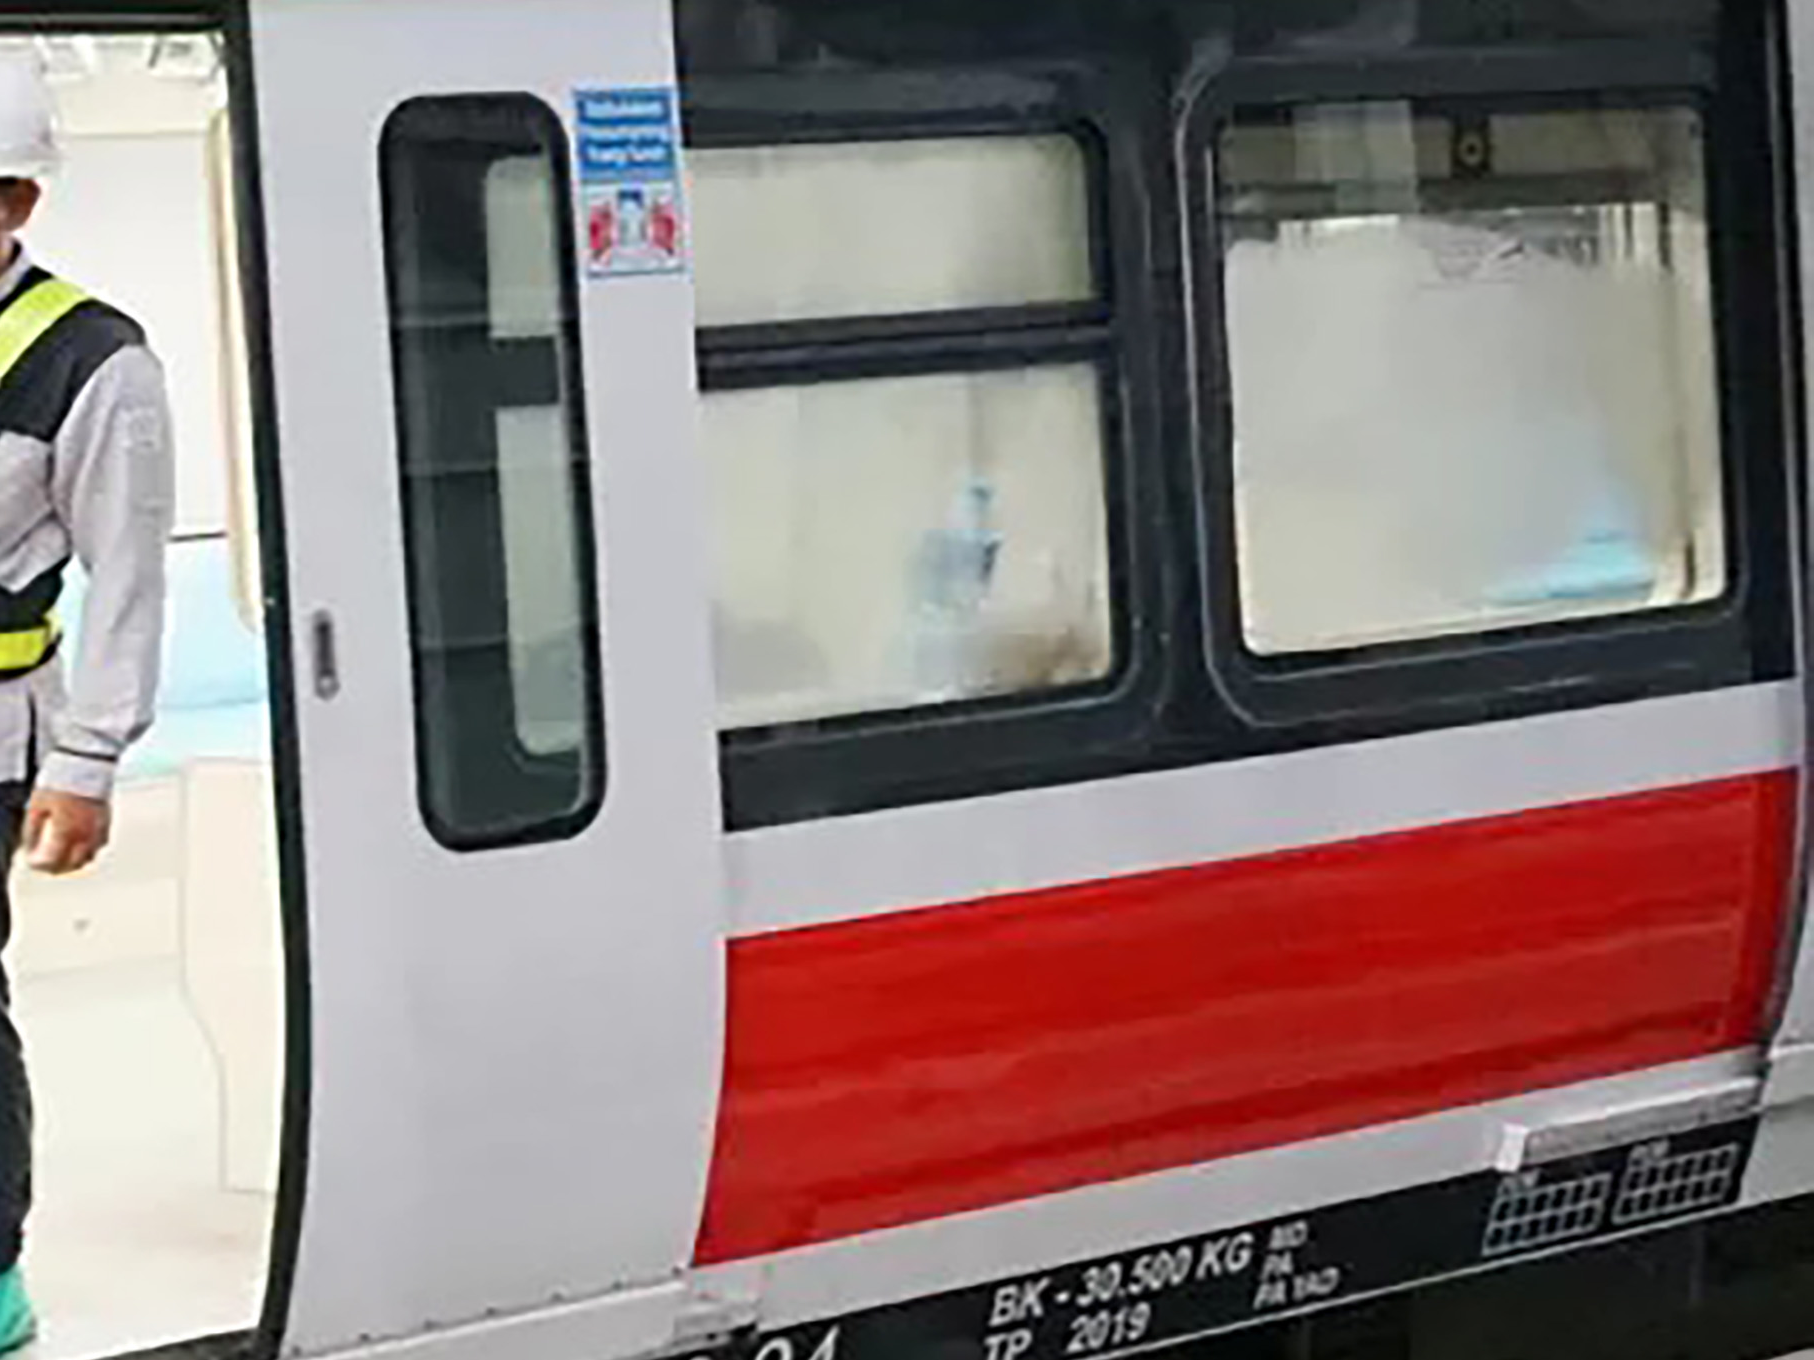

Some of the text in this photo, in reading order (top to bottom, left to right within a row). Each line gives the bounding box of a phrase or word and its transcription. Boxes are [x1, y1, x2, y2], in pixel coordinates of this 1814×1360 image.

[988, 1278, 1052, 1327] BK
[1076, 1246, 1193, 1307] 30.500
[1196, 1232, 1255, 1279] KG
[1066, 1302, 1152, 1354] 2019
